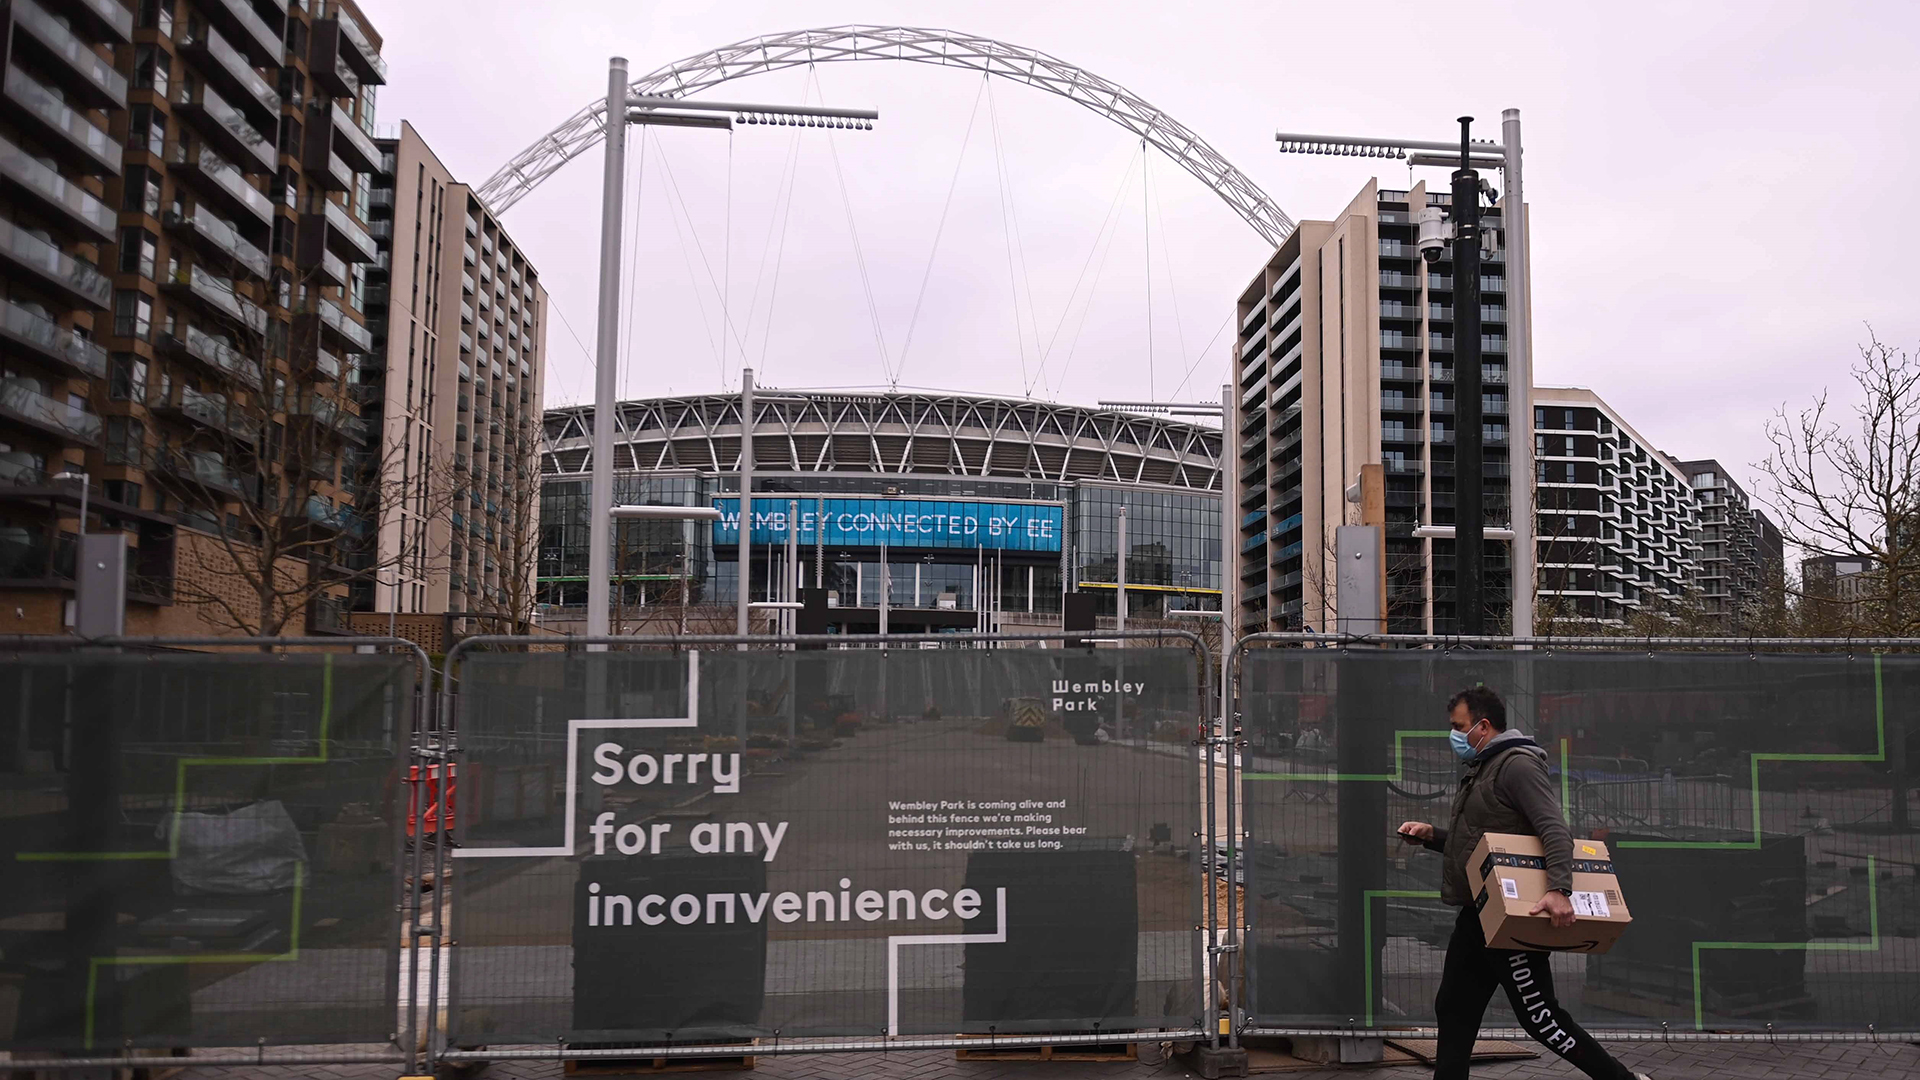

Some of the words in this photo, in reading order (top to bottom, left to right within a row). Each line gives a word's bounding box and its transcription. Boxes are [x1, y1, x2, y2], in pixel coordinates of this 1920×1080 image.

[720, 511, 833, 531] WMBLEY
[836, 512, 978, 535] CONNECTED
[988, 516, 1019, 536] BY
[1027, 518, 1053, 538] EE
[1052, 680, 1145, 695] Wembley
[1052, 698, 1097, 711] Park
[591, 742, 740, 794] Sorry
[888, 801, 938, 811] Wembley
[940, 800, 965, 810] Park
[967, 800, 977, 809] is
[978, 800, 1017, 811] coming
[1018, 799, 1044, 809] alive
[1046, 799, 1066, 809] and
[888, 814, 925, 824] behind
[926, 814, 948, 823] this
[949, 813, 980, 823] fence
[982, 813, 1012, 823] we're
[1013, 812, 1052, 824] making
[589, 811, 672, 856] for
[689, 821, 789, 862] any
[888, 829, 943, 838] necessary
[945, 827, 1024, 838] improvements.
[1026, 826, 1061, 835] Please
[1062, 825, 1087, 835] bear
[888, 841, 914, 850] with
[915, 842, 931, 851] us,
[933, 840, 942, 849] it
[944, 840, 994, 850] shouldn't
[996, 839, 1021, 849] take
[1023, 841, 1036, 849] us
[1038, 839, 1064, 850] long.
[588, 877, 982, 927] inconvenience
[1508, 953, 1577, 1054] HOLLISTER
